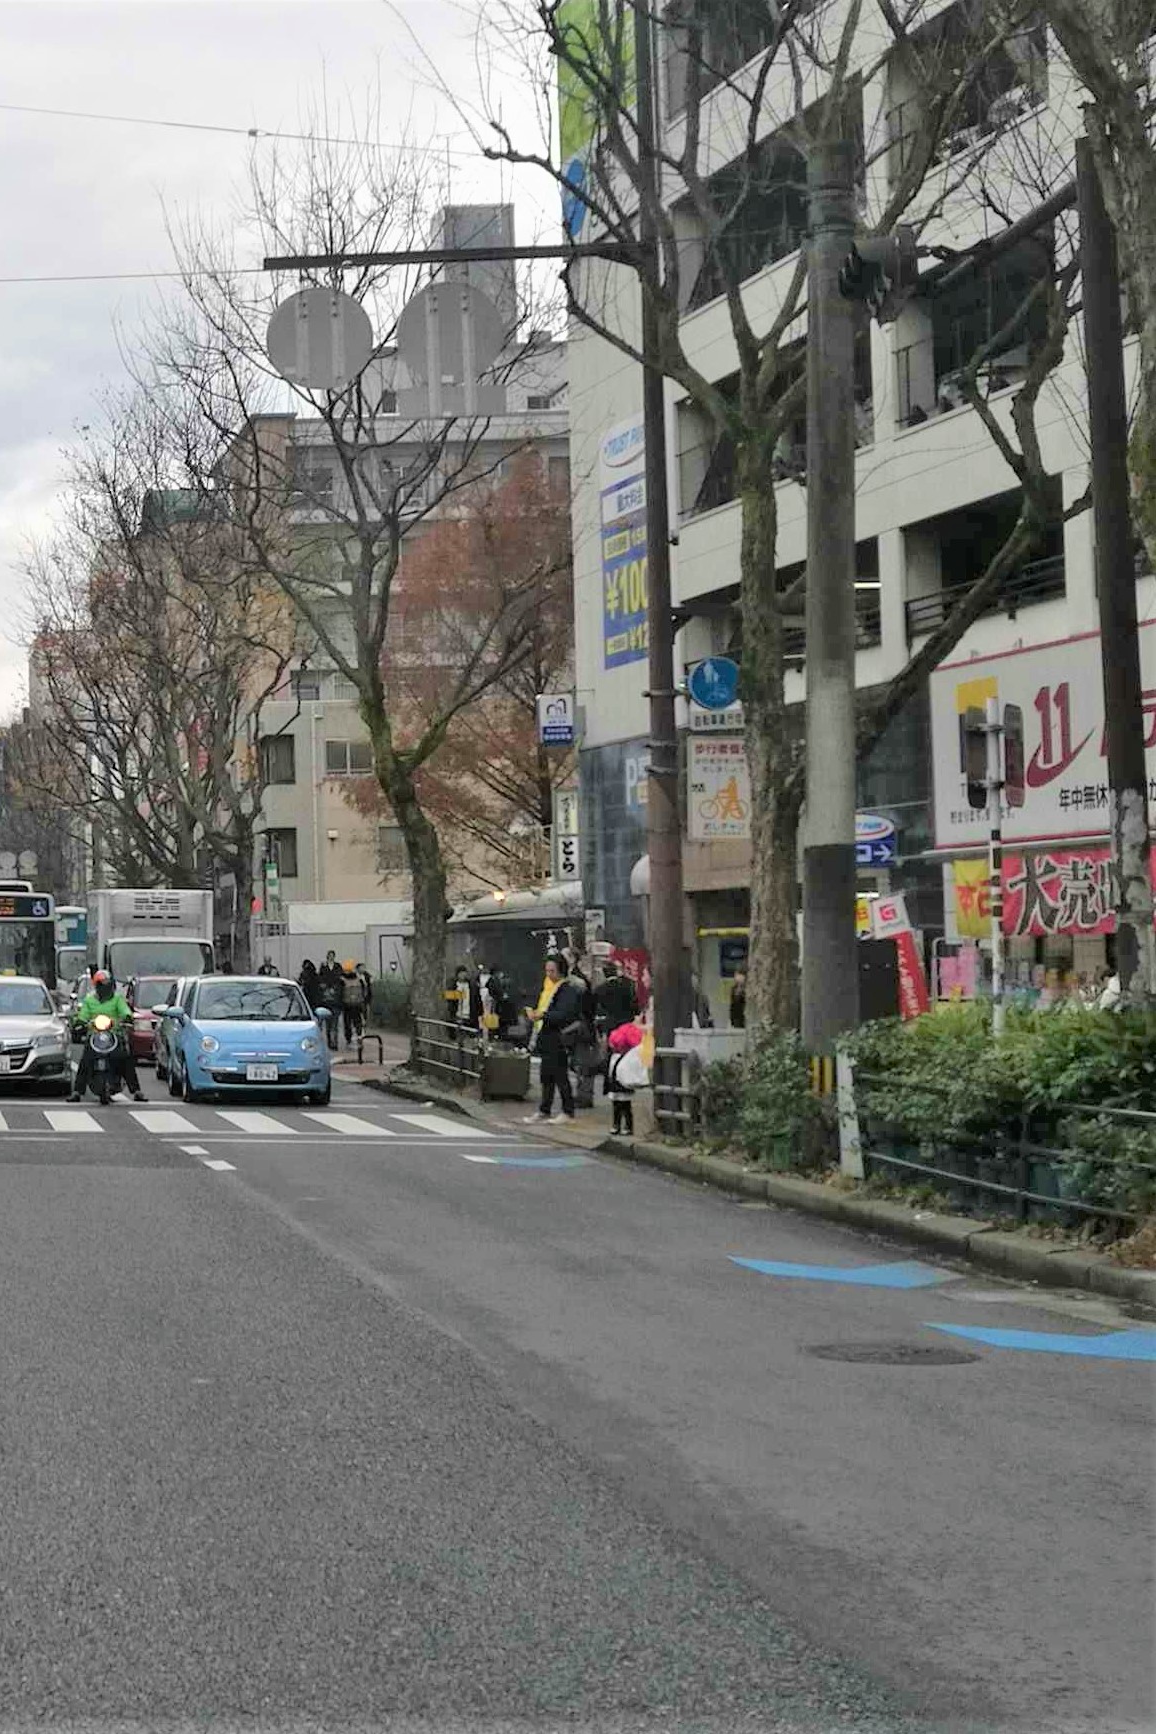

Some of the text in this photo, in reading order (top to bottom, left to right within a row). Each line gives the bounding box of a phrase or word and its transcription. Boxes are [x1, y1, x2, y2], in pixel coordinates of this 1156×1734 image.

[1059, 784, 1109, 812] 年中無休
[561, 840, 576, 873] とら
[1007, 852, 1119, 936] 大売出
